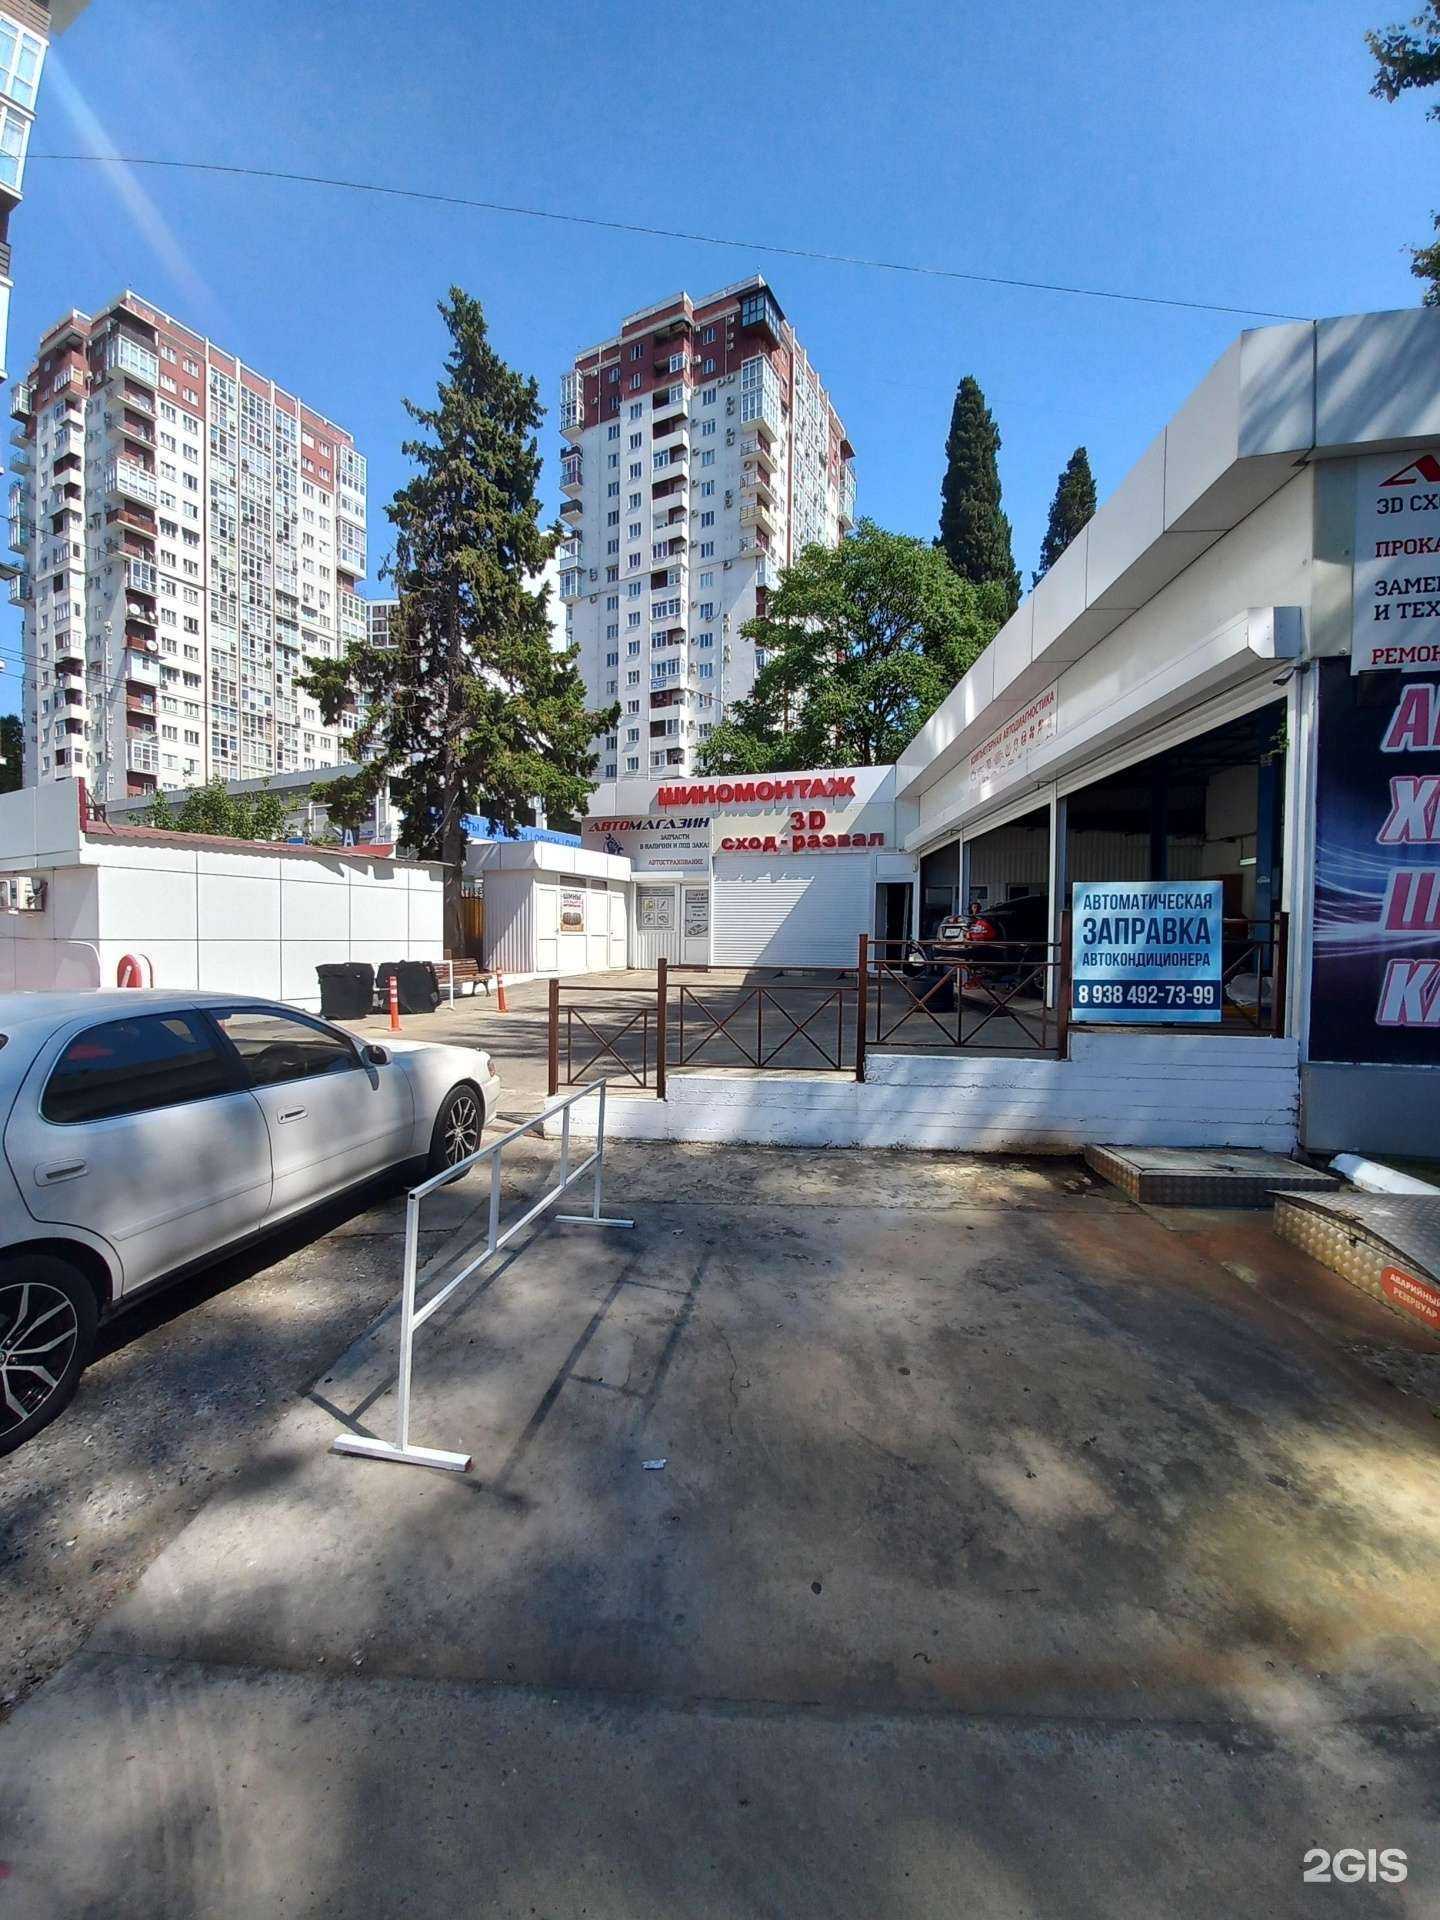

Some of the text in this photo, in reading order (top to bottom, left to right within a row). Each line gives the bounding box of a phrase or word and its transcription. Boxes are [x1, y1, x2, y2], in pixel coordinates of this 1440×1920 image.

[1377, 493, 1440, 514] 3D СХ
[1375, 576, 1440, 596] ЗАМЕ
[1374, 604, 1391, 620] И
[658, 776, 856, 806] ШИНОМОНТАЖ
[588, 817, 711, 832] АВТОМАГАЗИН
[790, 810, 827, 832] 3D
[1083, 893, 1213, 911] АВТОМАТИЧЕСКАЯ
[1082, 917, 1211, 946] ЗАПРАВКА
[1082, 952, 1211, 968] АВТОКОНДИЦИОНЕРА
[1078, 985, 1214, 1005] 8 938 492-73-99
